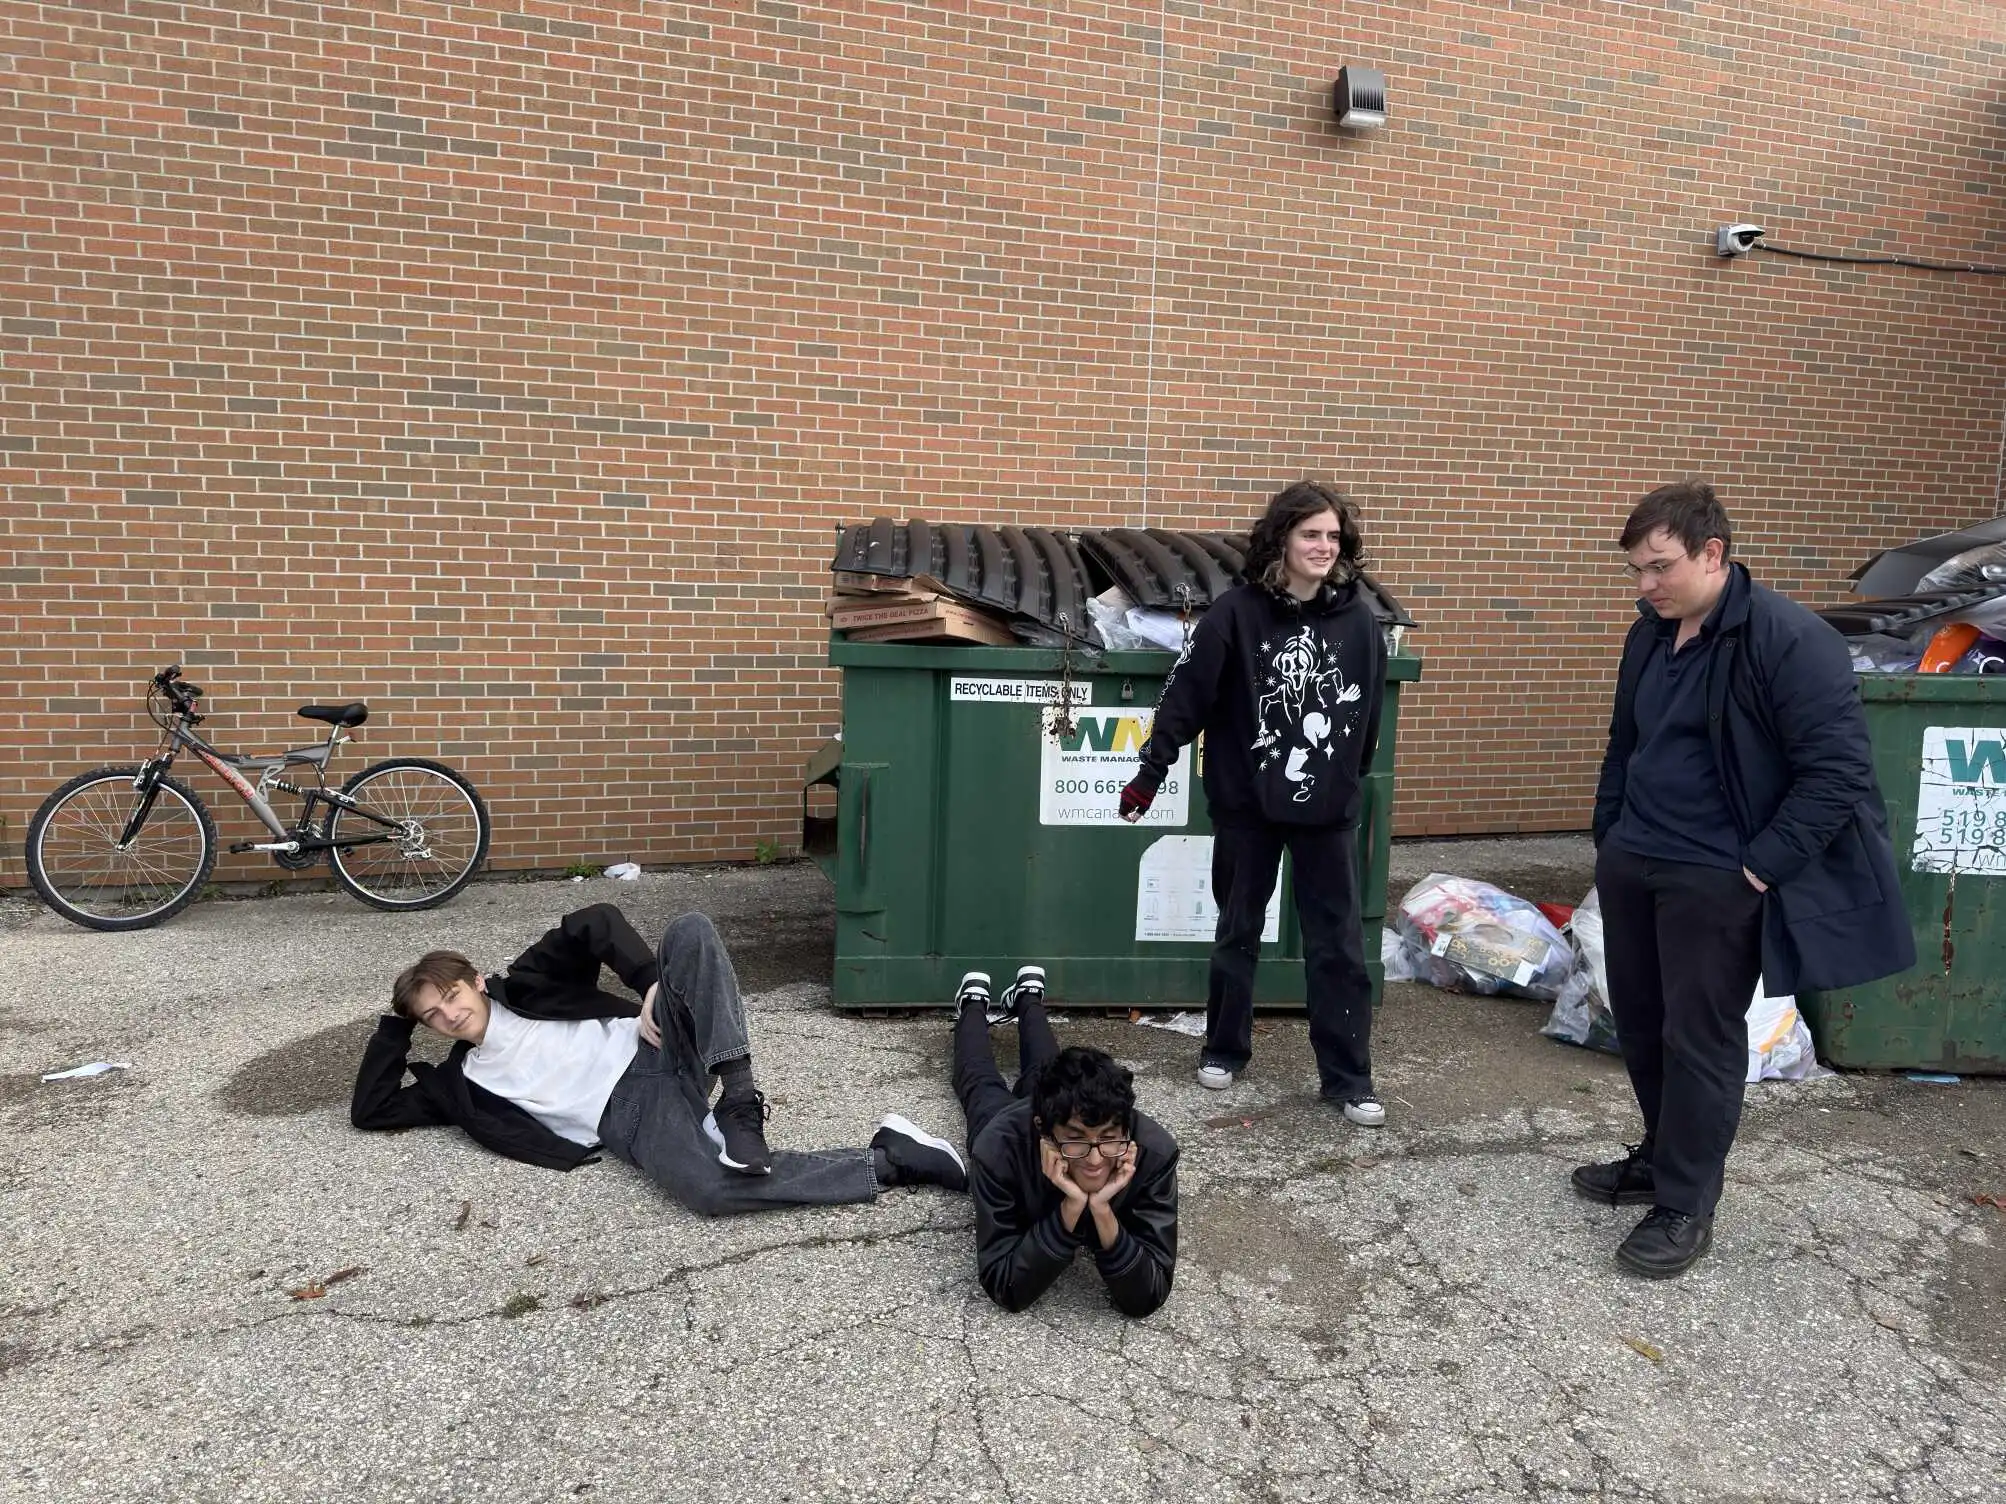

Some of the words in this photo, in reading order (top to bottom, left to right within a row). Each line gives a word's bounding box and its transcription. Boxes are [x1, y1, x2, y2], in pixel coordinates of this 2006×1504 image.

[874, 612, 888, 621] THE
[908, 608, 929, 617] PIZZA
[954, 683, 1022, 697] RECYCLABLE
[1026, 684, 1058, 698] ITEMS
[1061, 755, 1098, 763] WASTE
[1055, 779, 1089, 794] 800
[1942, 810, 1986, 827] 519
[1940, 828, 1984, 845] 519
